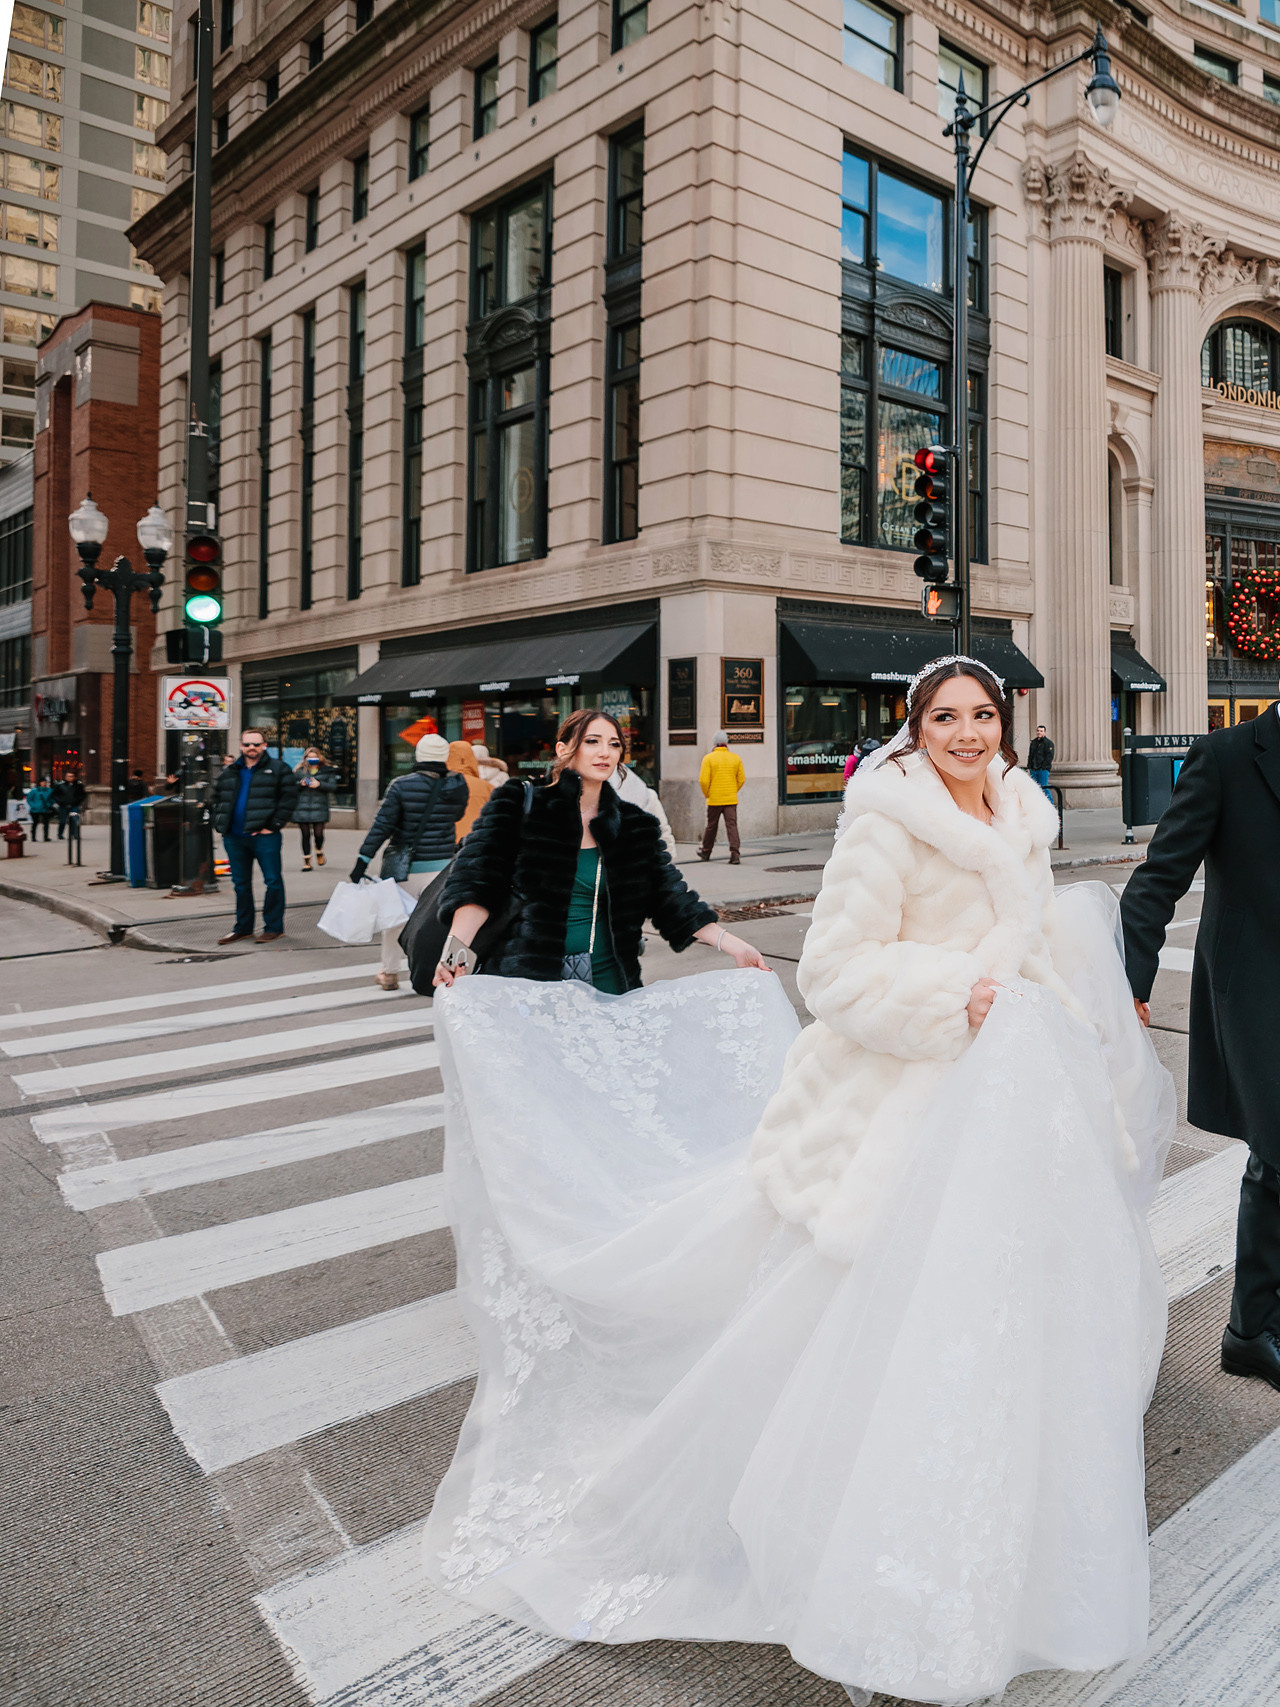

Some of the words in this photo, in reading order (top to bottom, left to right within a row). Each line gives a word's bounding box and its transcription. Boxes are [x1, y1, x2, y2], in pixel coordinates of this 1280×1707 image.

[1121, 114, 1189, 173] LONDON
[733, 667, 753, 679] 360
[603, 690, 629, 703] NOW
[1154, 736, 1200, 746] NEWSP
